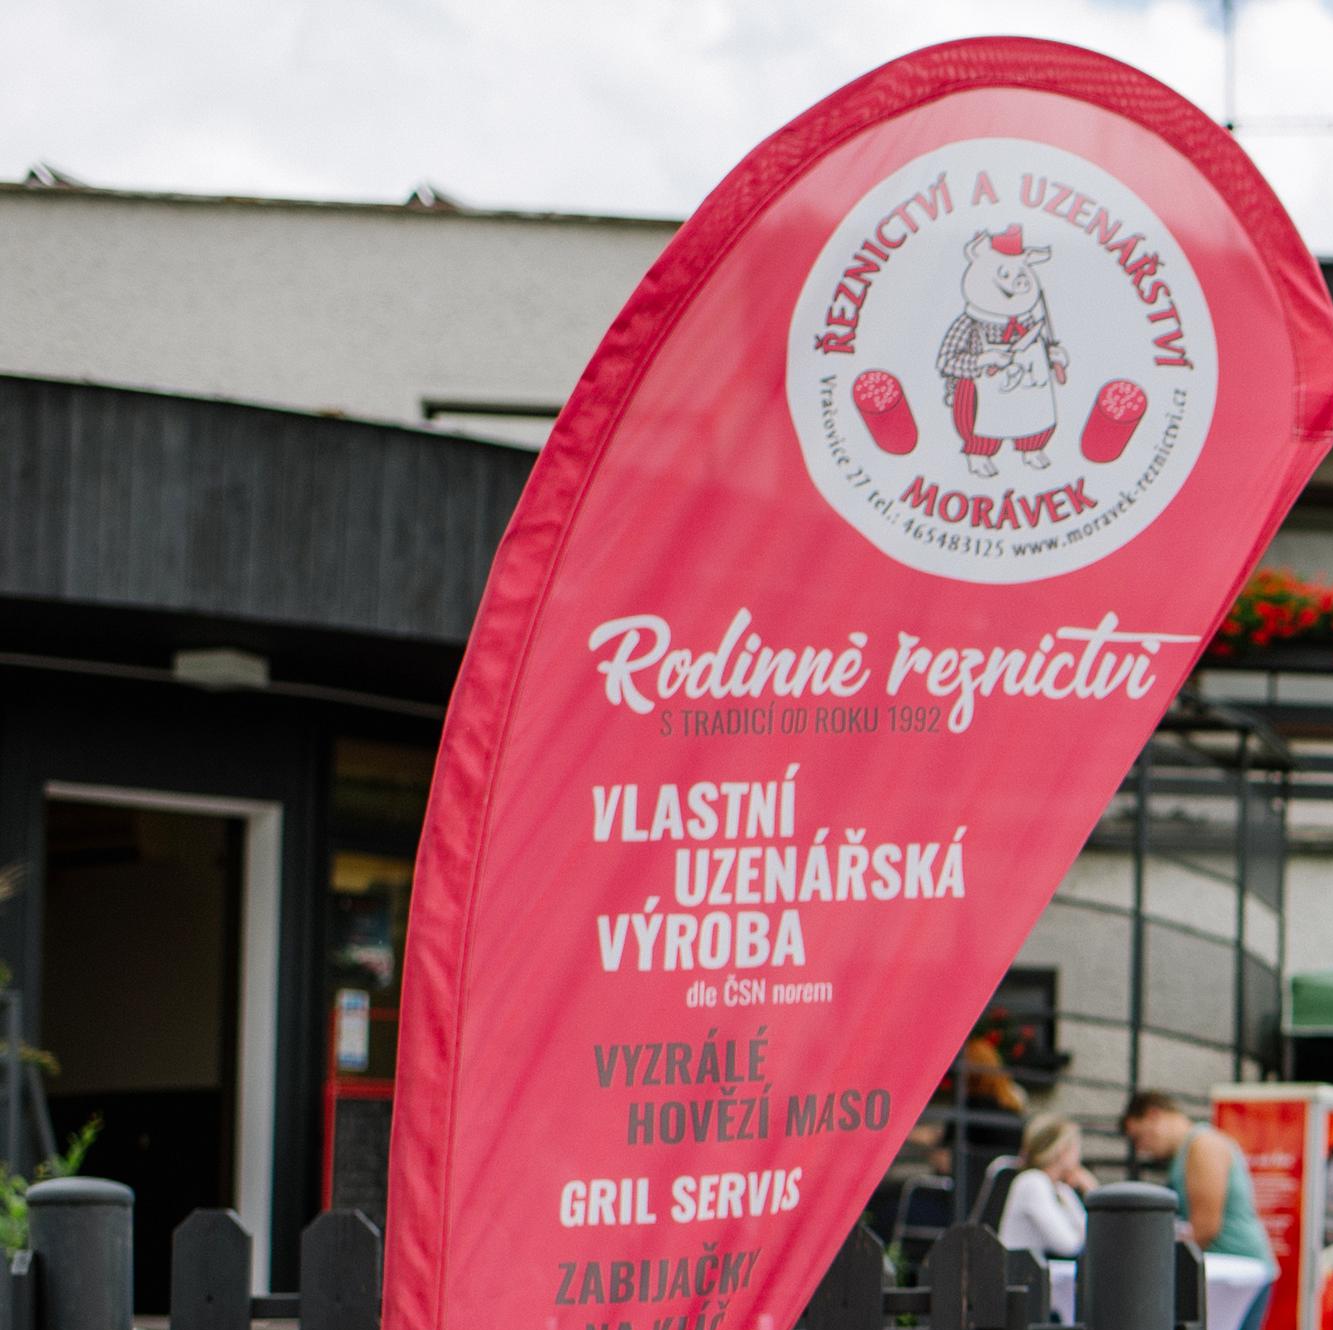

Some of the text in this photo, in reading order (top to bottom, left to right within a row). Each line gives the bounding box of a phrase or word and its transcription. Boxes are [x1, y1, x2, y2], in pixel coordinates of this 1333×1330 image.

[815, 170, 1194, 370] ŘEZNICTVÍ A UZENÁŘSTVÍ
[899, 475, 1099, 530] MORÁVEK
[588, 607, 1202, 733] Rodinné řeznictví
[659, 701, 942, 737] S TRADICÍ OD ROKU 1992
[592, 763, 801, 843] VLASTNÍ
[674, 826, 967, 908] UZENÁŘSKÁ
[597, 896, 806, 972] VÝROBA
[686, 974, 834, 1009] dle ČSN norem
[593, 1025, 770, 1089] VYZRÁLÉ
[626, 1083, 892, 1146] HOVĚZÍ MASO
[558, 1167, 803, 1228] GRIL SERVIS
[554, 1242, 763, 1307] ZABIJAČKY
